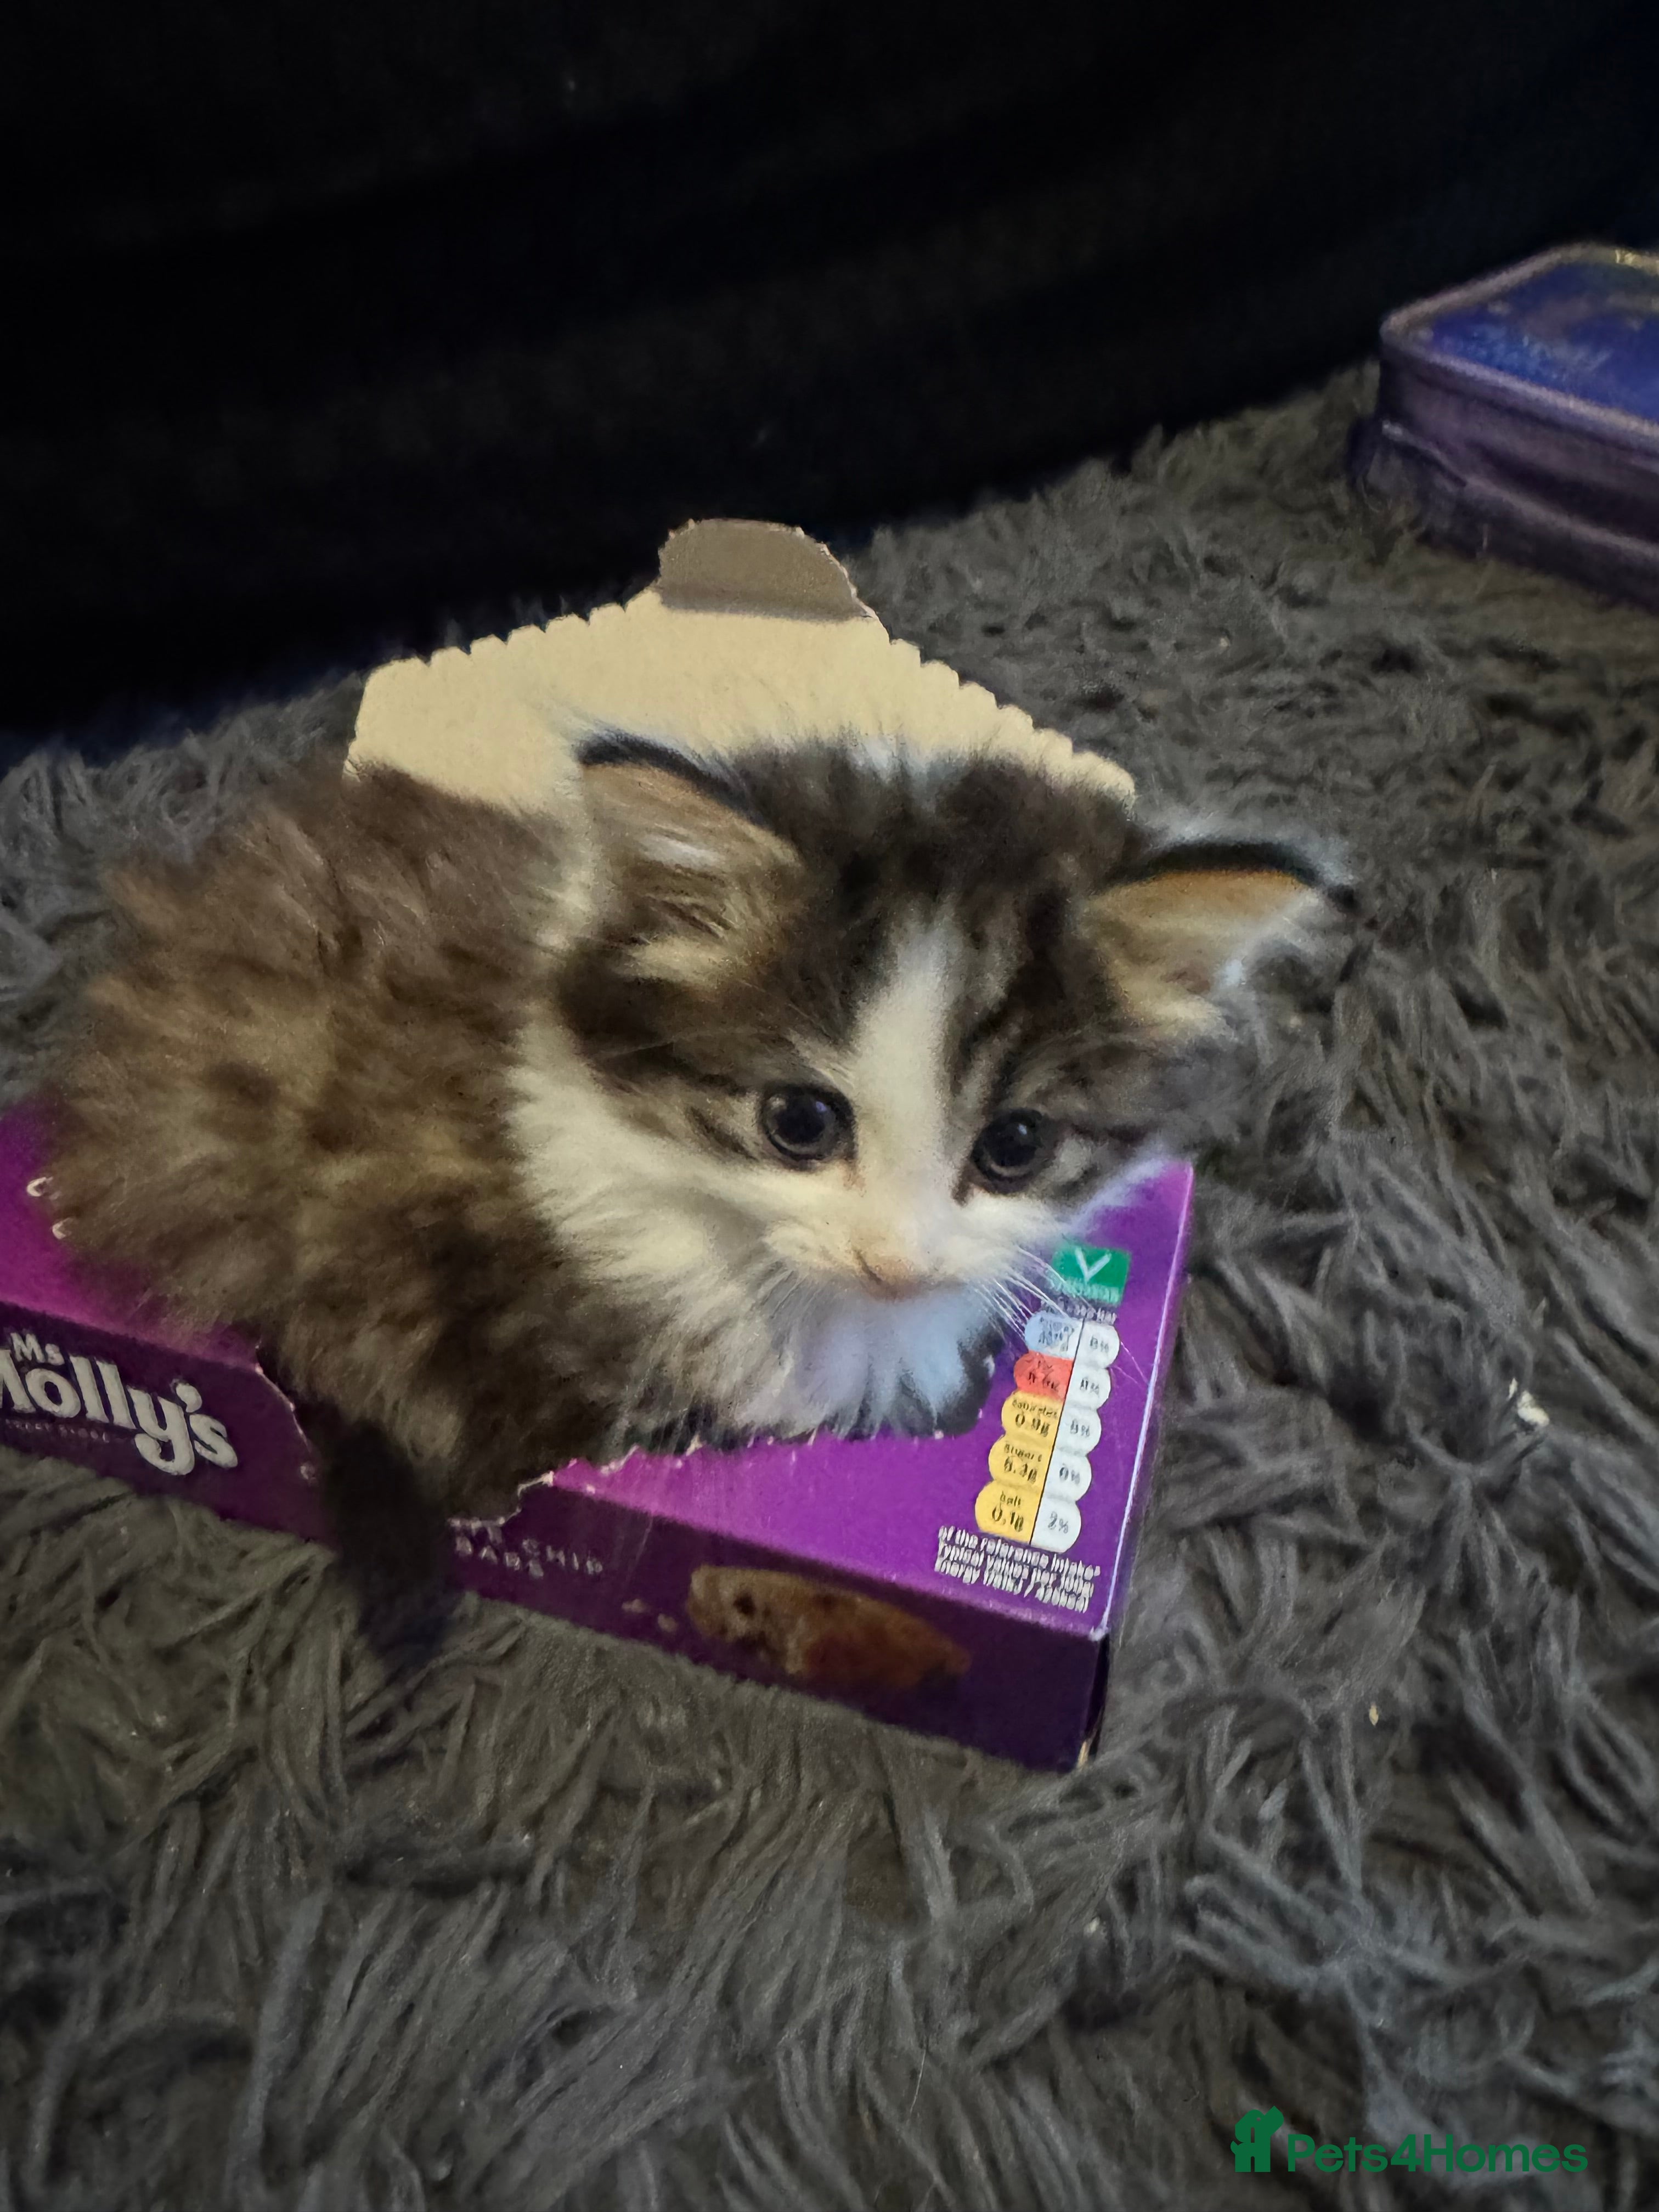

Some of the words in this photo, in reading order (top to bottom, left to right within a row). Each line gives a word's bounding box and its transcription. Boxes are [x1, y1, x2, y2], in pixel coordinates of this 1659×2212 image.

[10, 1332, 65, 1366] Ms
[939, 1526, 955, 1542] of
[955, 1528, 978, 1549] the
